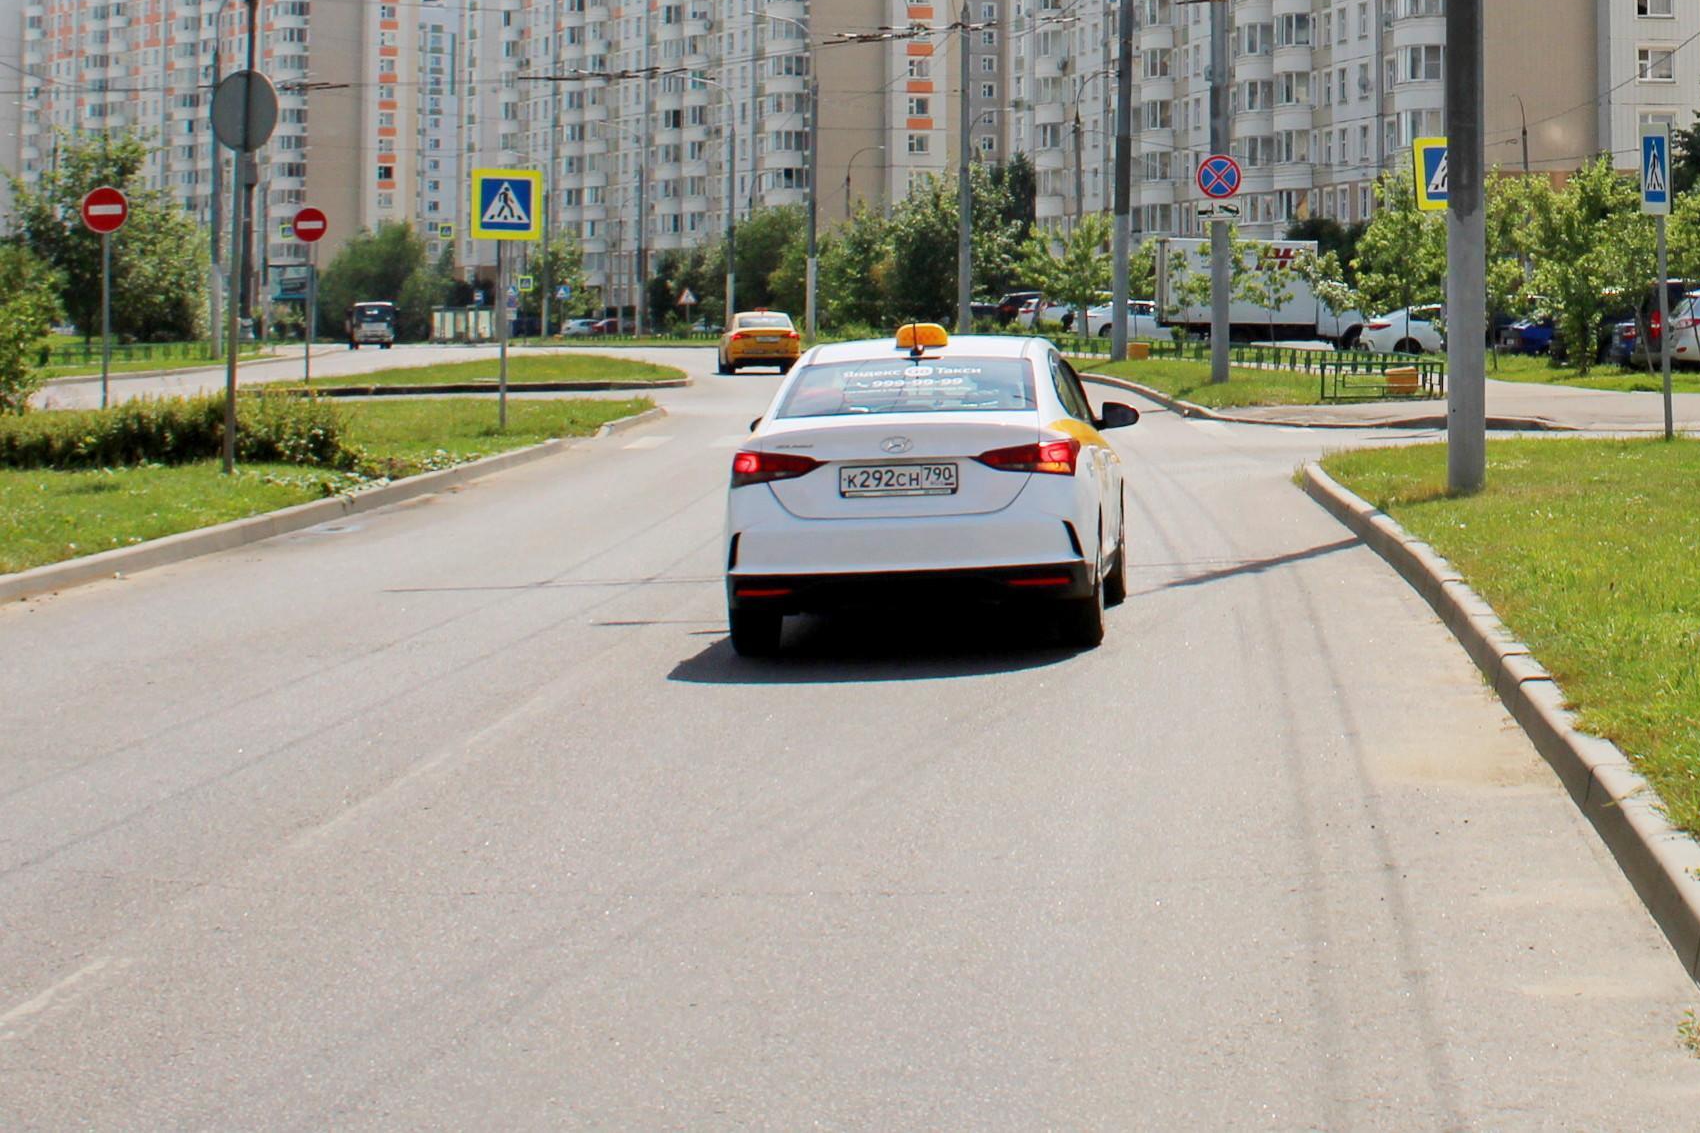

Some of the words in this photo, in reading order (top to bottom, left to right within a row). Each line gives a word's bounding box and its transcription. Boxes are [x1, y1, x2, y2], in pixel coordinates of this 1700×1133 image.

[843, 371, 901, 379] Яндекс
[872, 378, 963, 388] 999-99-99
[847, 471, 919, 489] К292СН
[924, 467, 949, 482] 790
